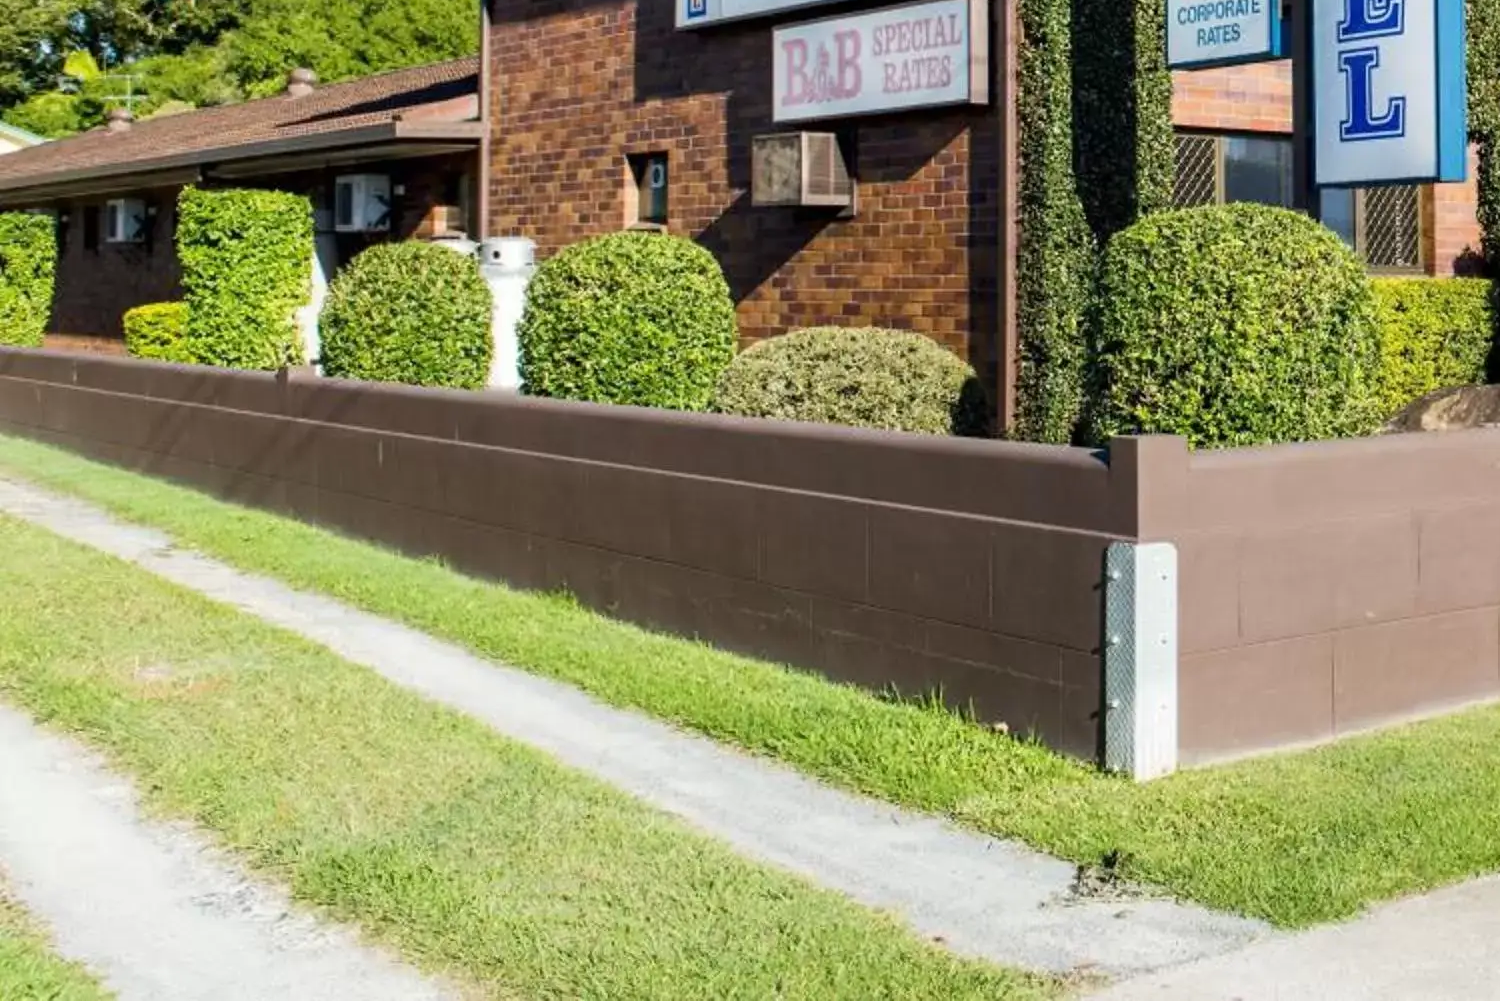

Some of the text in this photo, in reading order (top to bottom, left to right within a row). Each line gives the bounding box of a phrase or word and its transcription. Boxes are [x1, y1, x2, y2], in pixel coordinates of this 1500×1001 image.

[872, 13, 962, 56] SPECIAL
[1197, 23, 1241, 47] RATES
[882, 55, 952, 93] RATES
